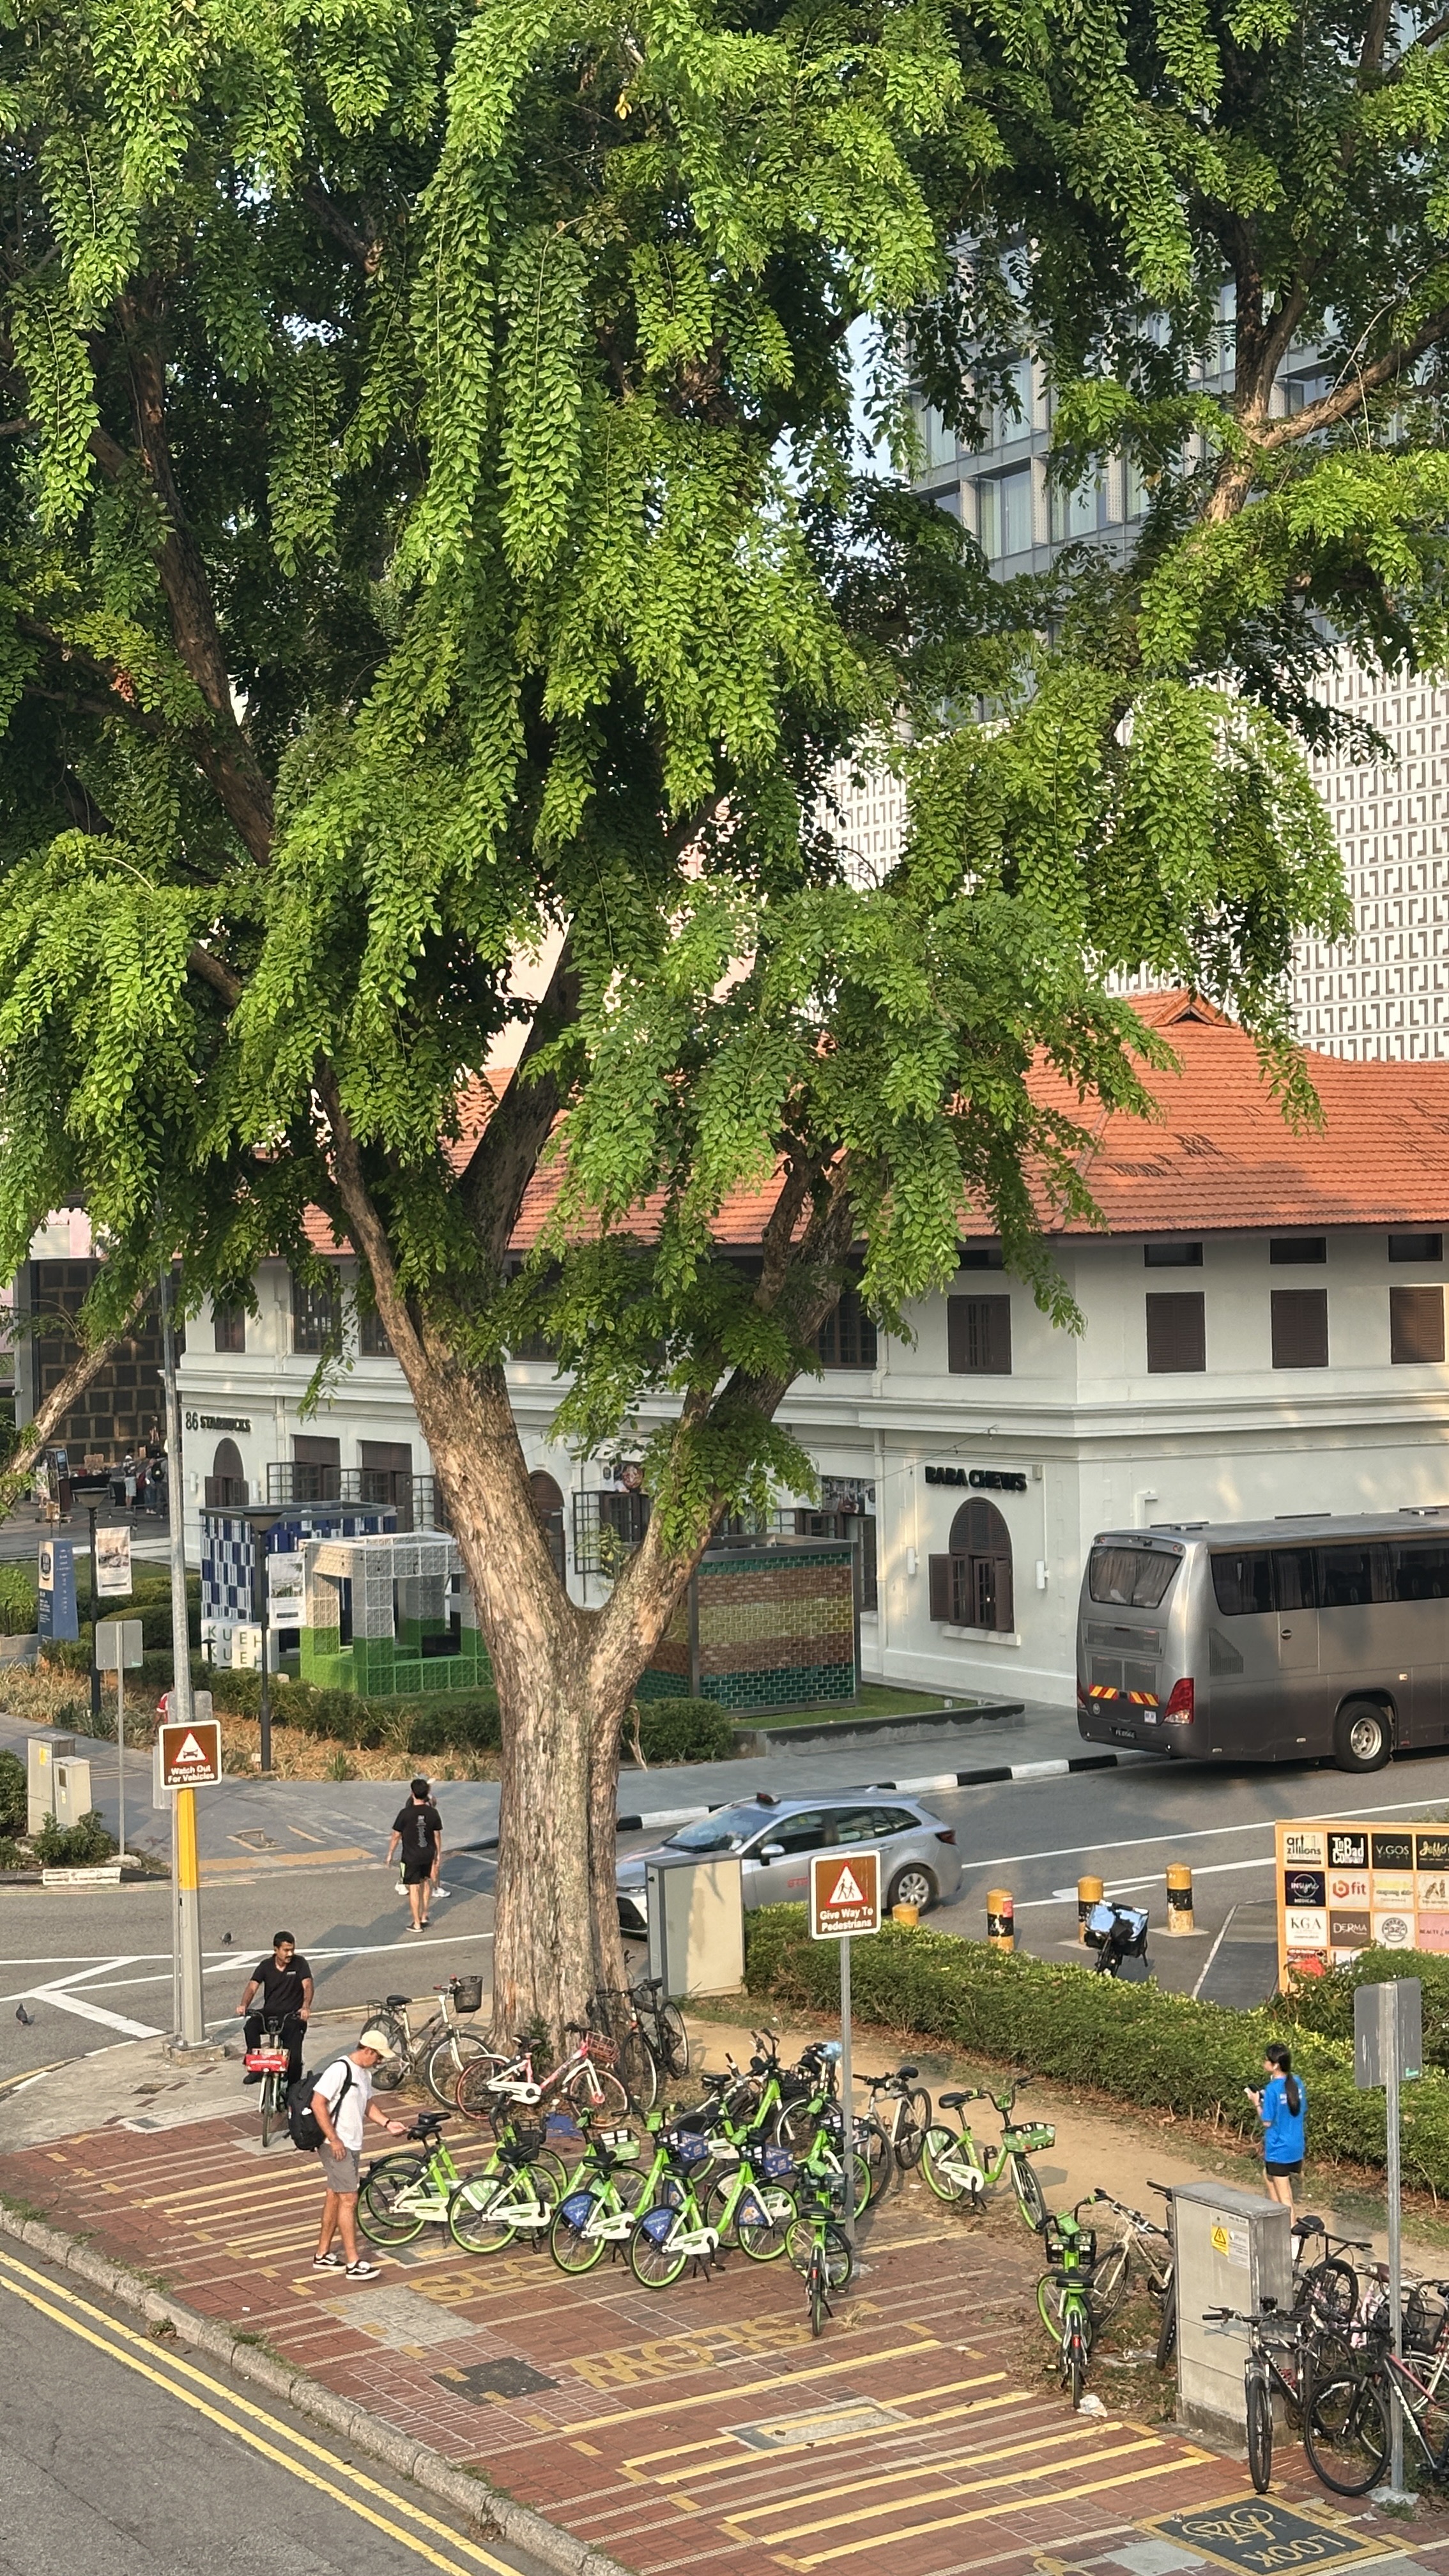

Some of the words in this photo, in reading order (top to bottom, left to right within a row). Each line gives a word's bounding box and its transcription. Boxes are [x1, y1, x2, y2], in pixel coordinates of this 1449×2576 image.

[185, 1411, 199, 1430] 86
[925, 1466, 969, 1486] BABA
[969, 1469, 1027, 1491] CHEWS
[171, 1766, 195, 1775] Watch
[196, 1765, 211, 1773] Out
[183, 1772, 215, 1781] Vehicles
[820, 1910, 840, 1920] Give
[841, 1908, 861, 1919] Way
[862, 1906, 874, 1916] To
[822, 1919, 872, 1932] Pedestrians
[1291, 1917, 1322, 1929] KGA
[1240, 2534, 1347, 2568] LOOK
